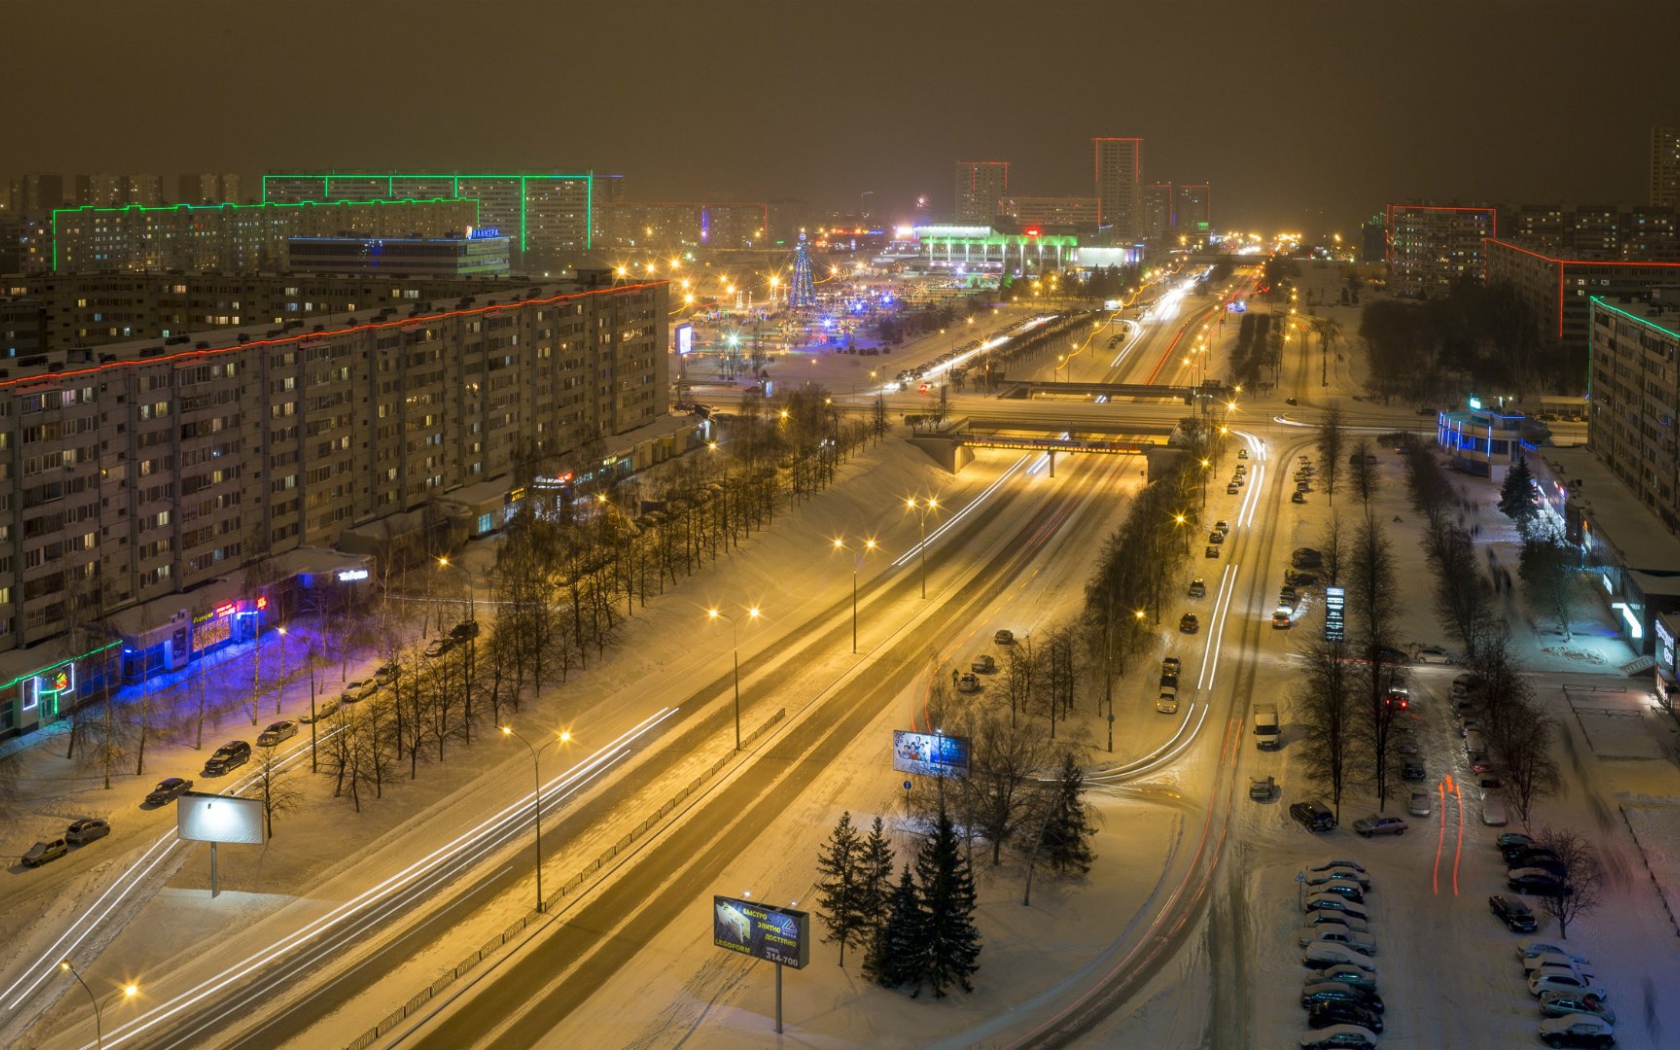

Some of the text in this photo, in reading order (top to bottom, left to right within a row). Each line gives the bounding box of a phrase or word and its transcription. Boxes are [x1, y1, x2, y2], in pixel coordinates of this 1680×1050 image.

[743, 908, 767, 919] БЫСТРО
[764, 933, 797, 947] ДОСТУПНО
[766, 952, 798, 966] 314-700
